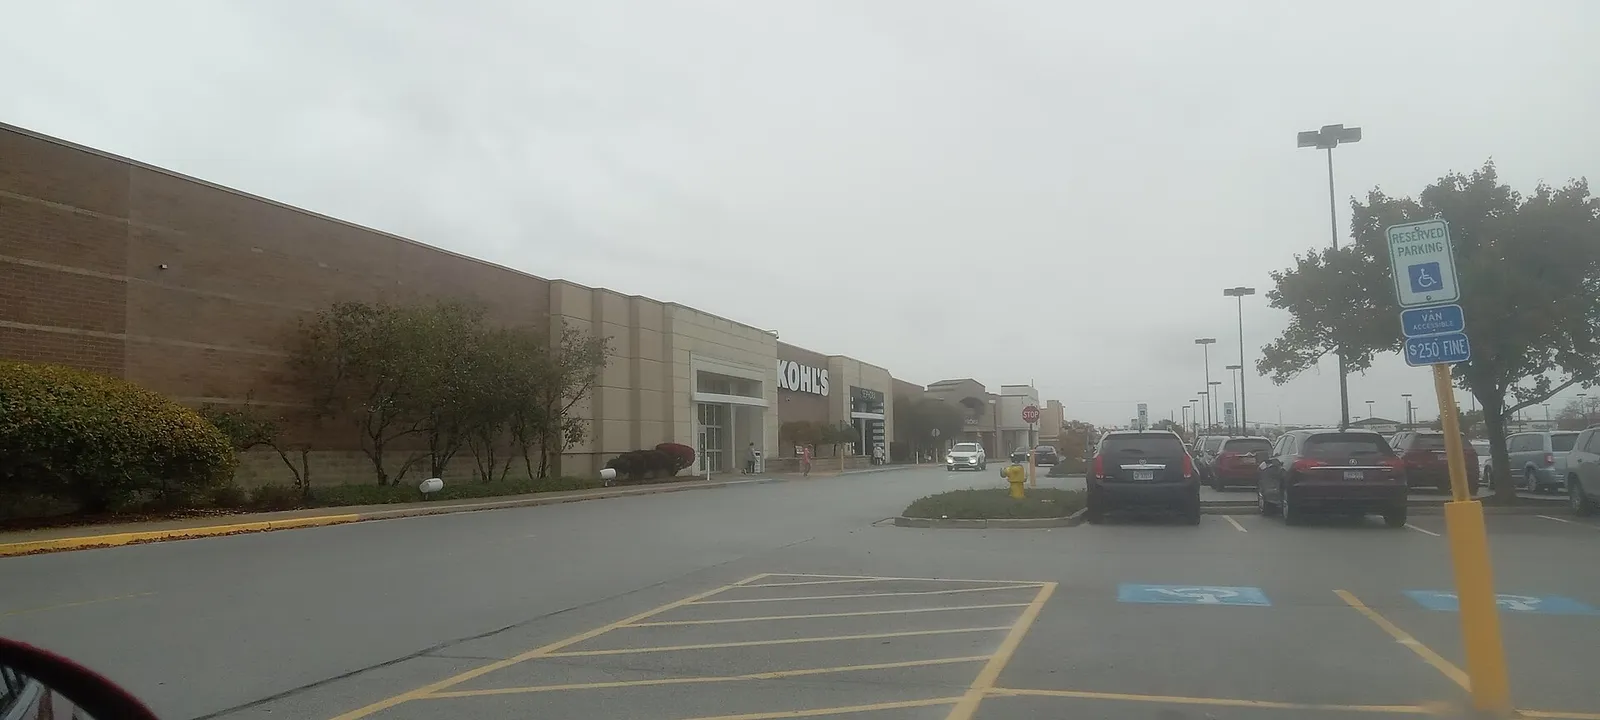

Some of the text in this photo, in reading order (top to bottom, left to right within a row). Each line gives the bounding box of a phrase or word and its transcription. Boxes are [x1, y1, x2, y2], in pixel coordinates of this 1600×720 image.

[1392, 228, 1444, 244] RESERVED
[1398, 242, 1443, 257] PARKING
[1421, 312, 1442, 321] VAN
[1413, 320, 1454, 330] ACCESSIBLE
[1443, 339, 1467, 355] FINE
[777, 359, 829, 396] KOHL'S
[1023, 411, 1039, 419] STOP
